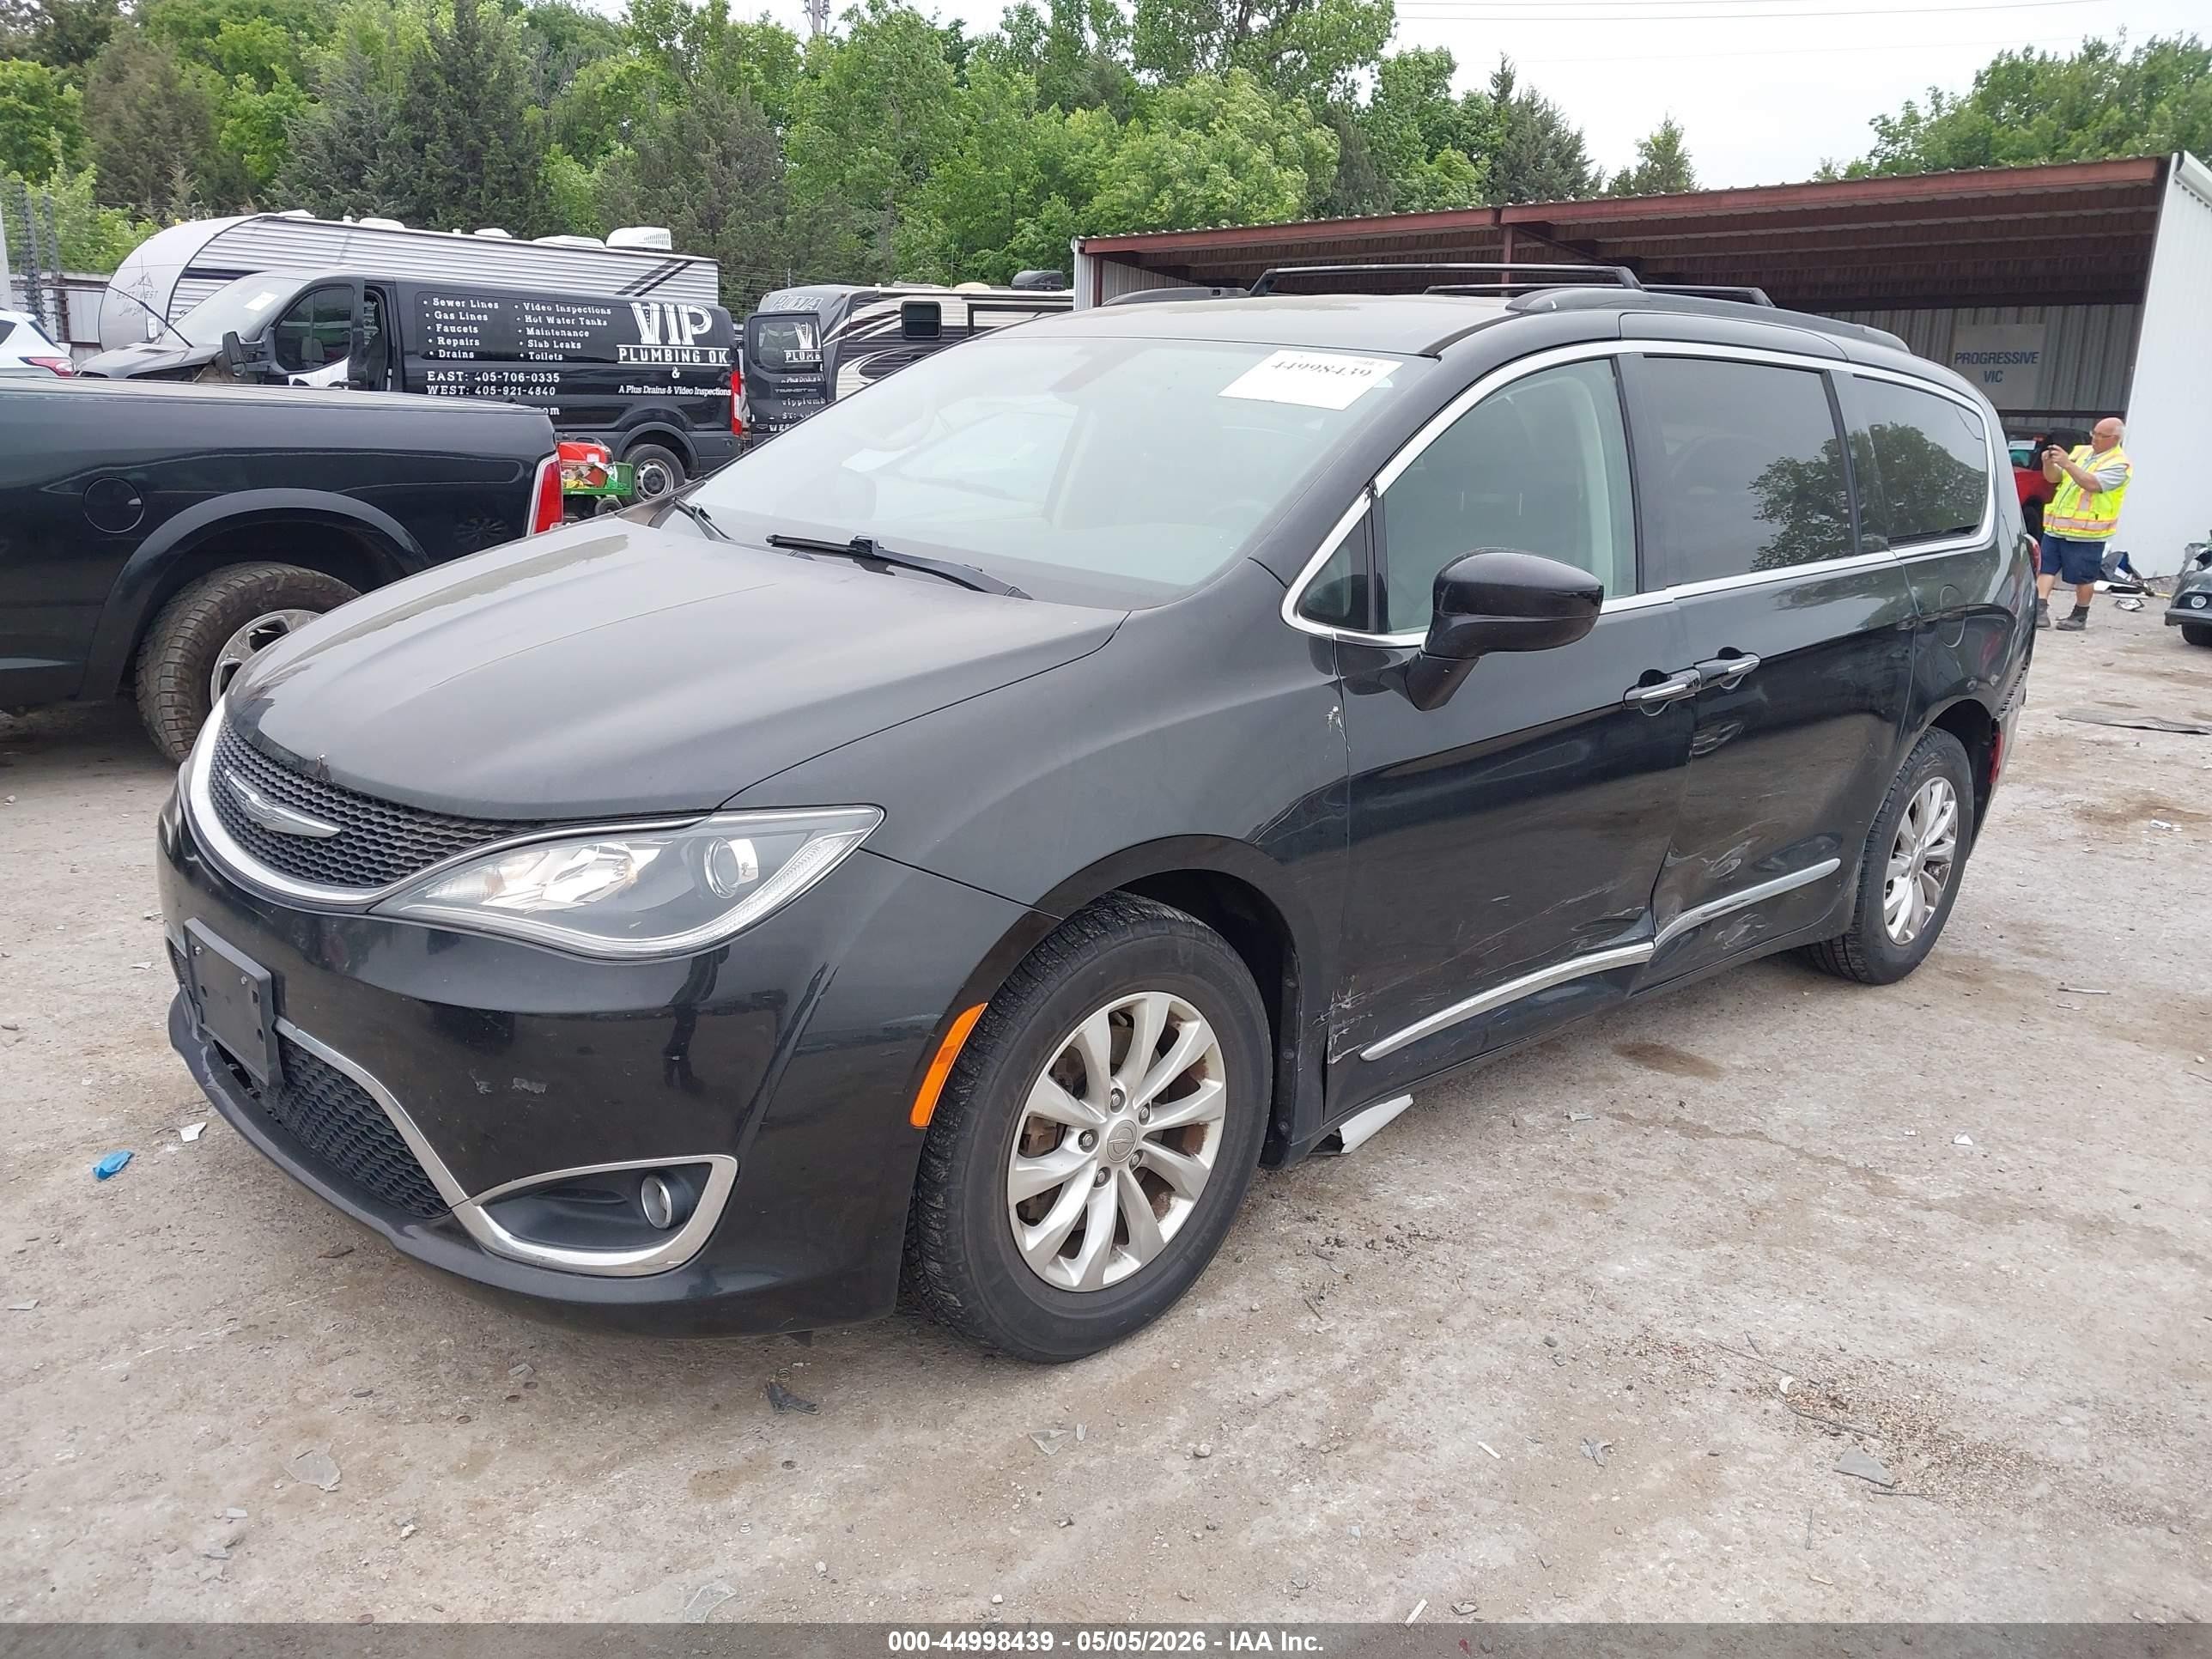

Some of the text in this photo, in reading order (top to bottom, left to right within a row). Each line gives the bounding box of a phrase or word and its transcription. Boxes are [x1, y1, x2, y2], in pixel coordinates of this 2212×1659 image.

[433, 297, 499, 309] Sewer Lines
[523, 302, 611, 315] Video Inspections
[434, 310, 488, 321] Gas Lines
[525, 314, 607, 326] Hot Water Tanks
[435, 323, 478, 334] Faucets
[629, 302, 713, 345] VIP
[526, 327, 589, 337] Maintenance
[436, 336, 480, 348] Repairs
[527, 339, 581, 349] Slab Leaks
[438, 349, 475, 359] Drains
[529, 351, 563, 361] Toilets
[618, 347, 727, 363] PLUMBING OK
[1954, 351, 2039, 364] PROGRESSIVE
[427, 370, 560, 383] EAST: 405-706-0335
[671, 366, 681, 379] &
[1984, 370, 2003, 383] VIC
[426, 385, 556, 396] WEST: 405-921-4840
[617, 385, 732, 398] A Plus Drains & Video Inspections
